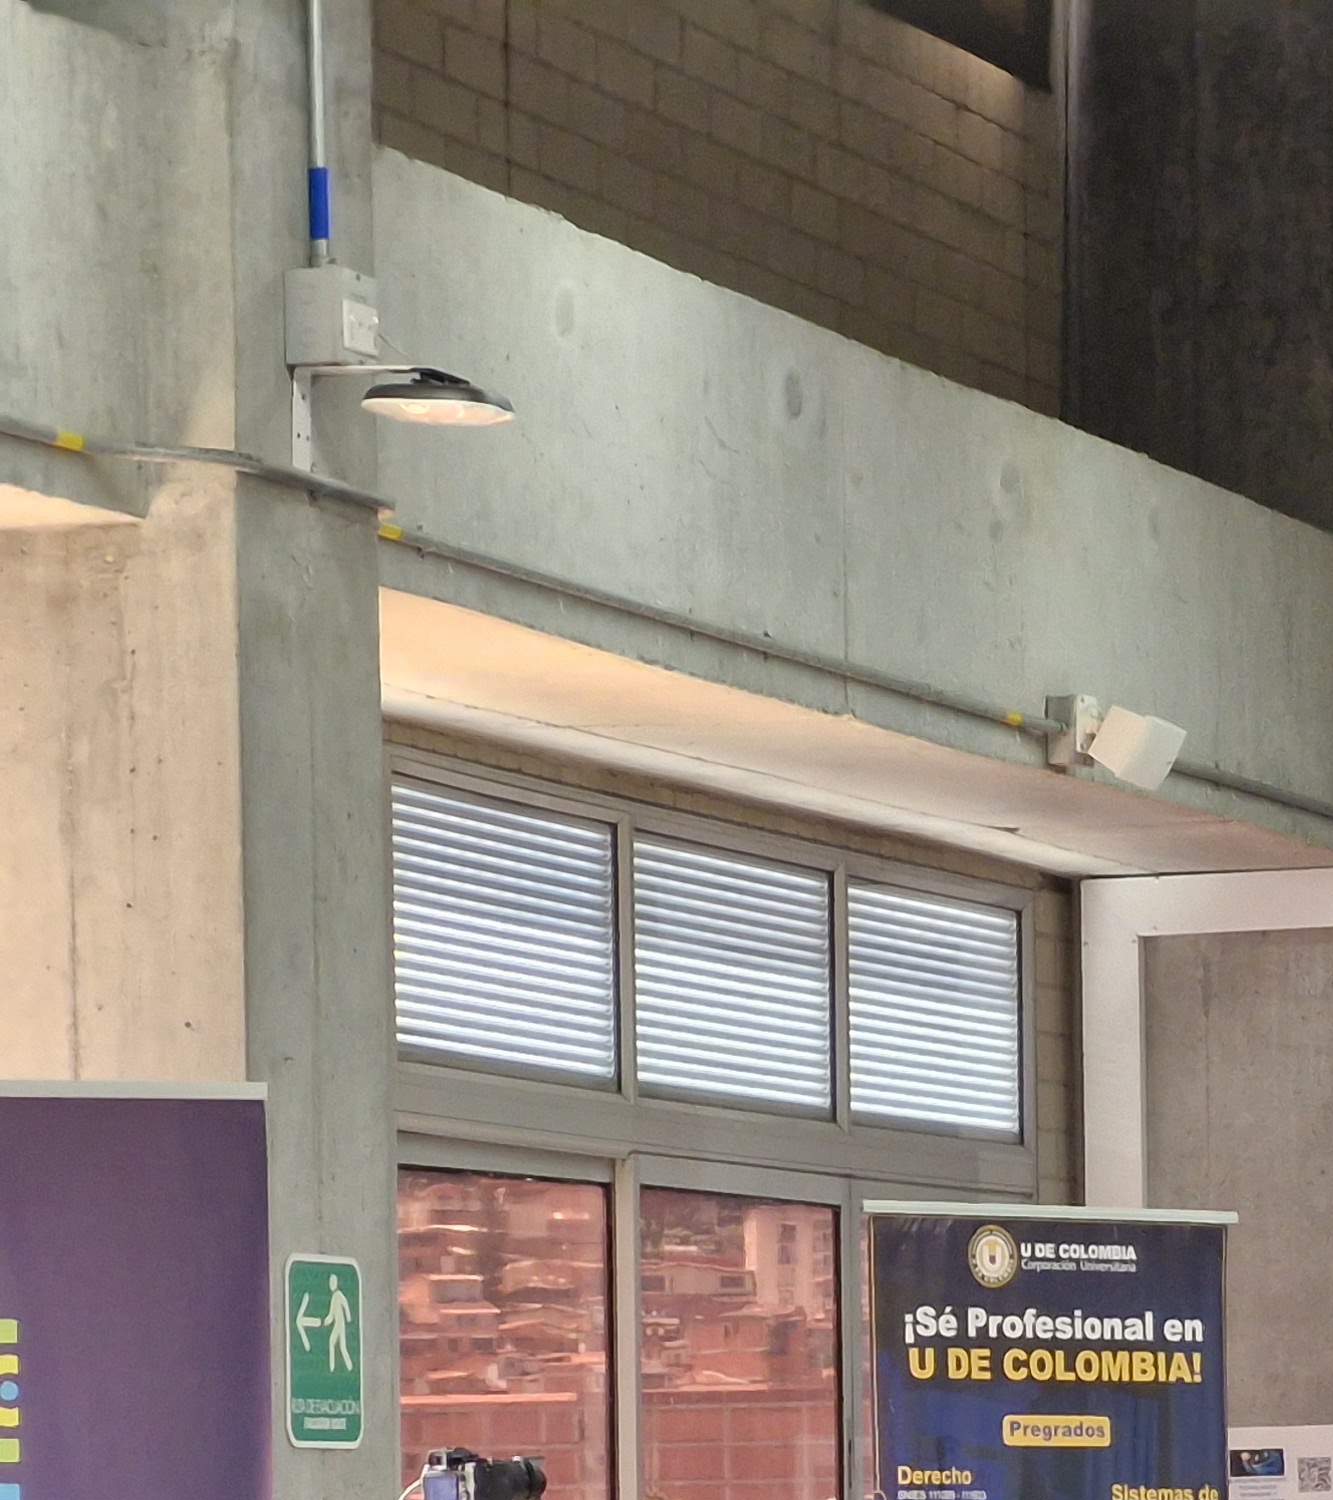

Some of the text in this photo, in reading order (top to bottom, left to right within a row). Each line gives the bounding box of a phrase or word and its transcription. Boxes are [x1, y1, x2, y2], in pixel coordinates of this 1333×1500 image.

[1021, 1243, 1137, 1260] U DE COLOMBIA
[904, 1305, 1204, 1343] ¡Sé Profesional en
[908, 1347, 1202, 1382] U DE COLOMBIA!
[1009, 1421, 1106, 1443] Pregrados
[897, 1465, 972, 1485] Derecho
